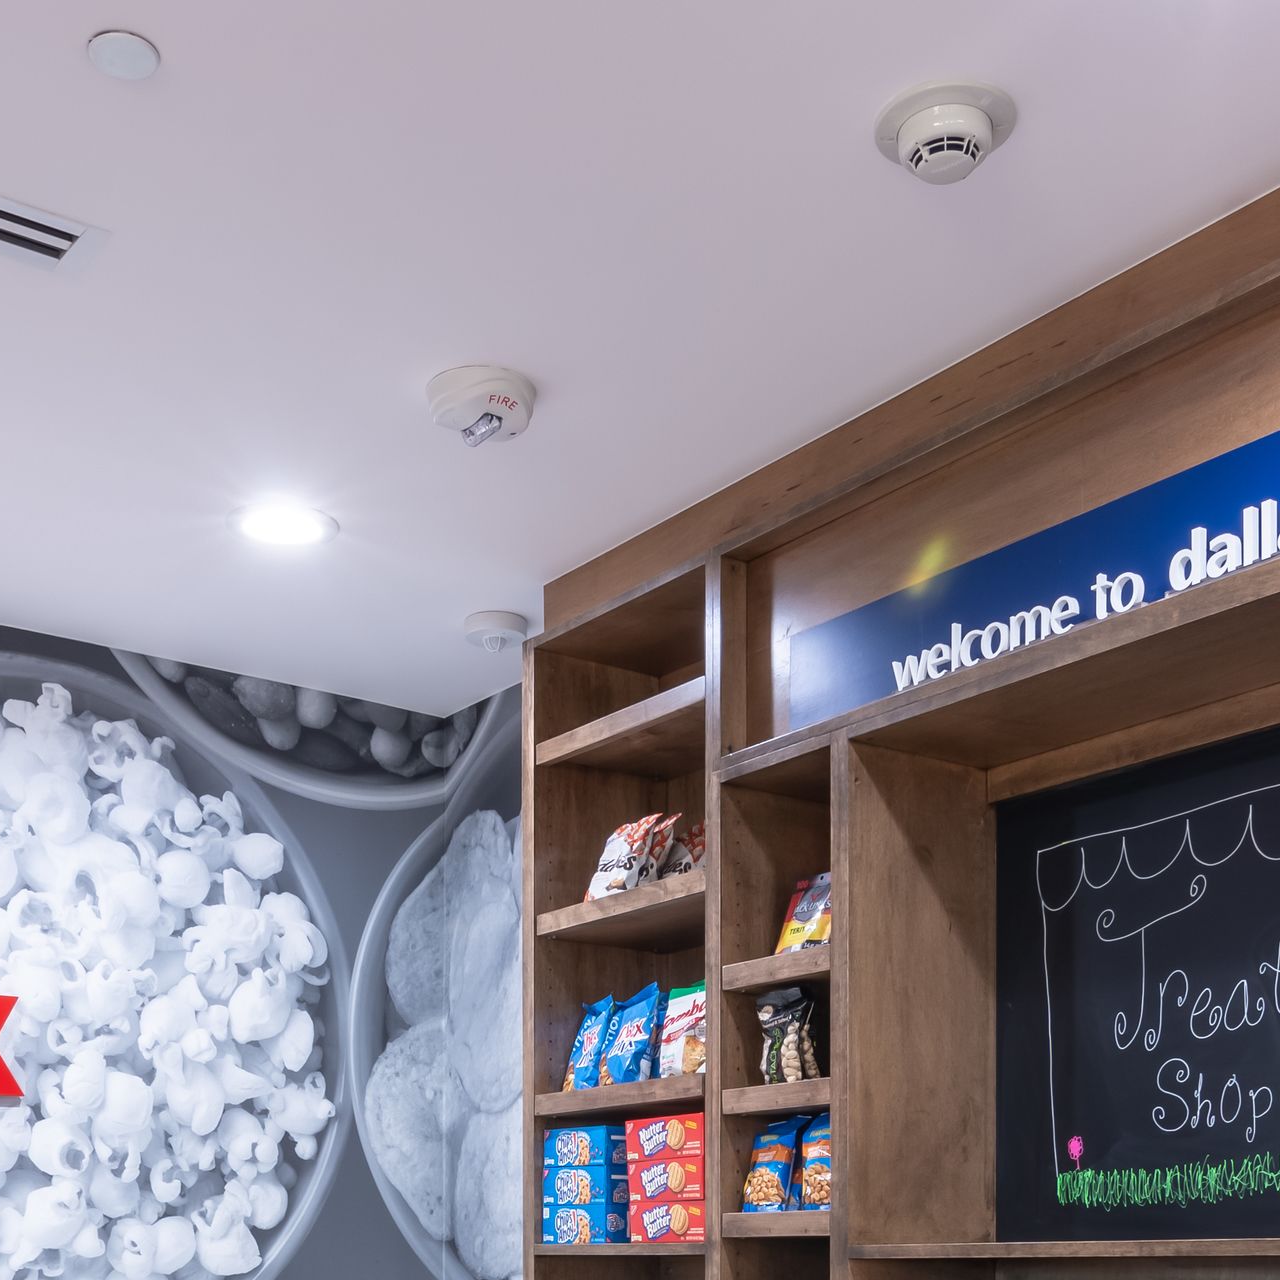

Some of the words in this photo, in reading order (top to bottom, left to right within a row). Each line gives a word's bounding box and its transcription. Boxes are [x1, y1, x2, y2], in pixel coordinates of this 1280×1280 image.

[488, 393, 518, 412] FIRE
[892, 596, 1079, 692] welcome
[1091, 571, 1144, 619] to
[1153, 1058, 1272, 1142] Shop
[639, 1122, 665, 1141] Nutter
[556, 1136, 574, 1154] Chips
[643, 1132, 669, 1156] Butter
[556, 1174, 574, 1192] Chips
[641, 1164, 666, 1182] Nutter
[645, 1174, 669, 1197] Butter
[555, 1213, 573, 1231] Chips
[642, 1205, 669, 1226] Nutter
[646, 1216, 672, 1239] Butter
